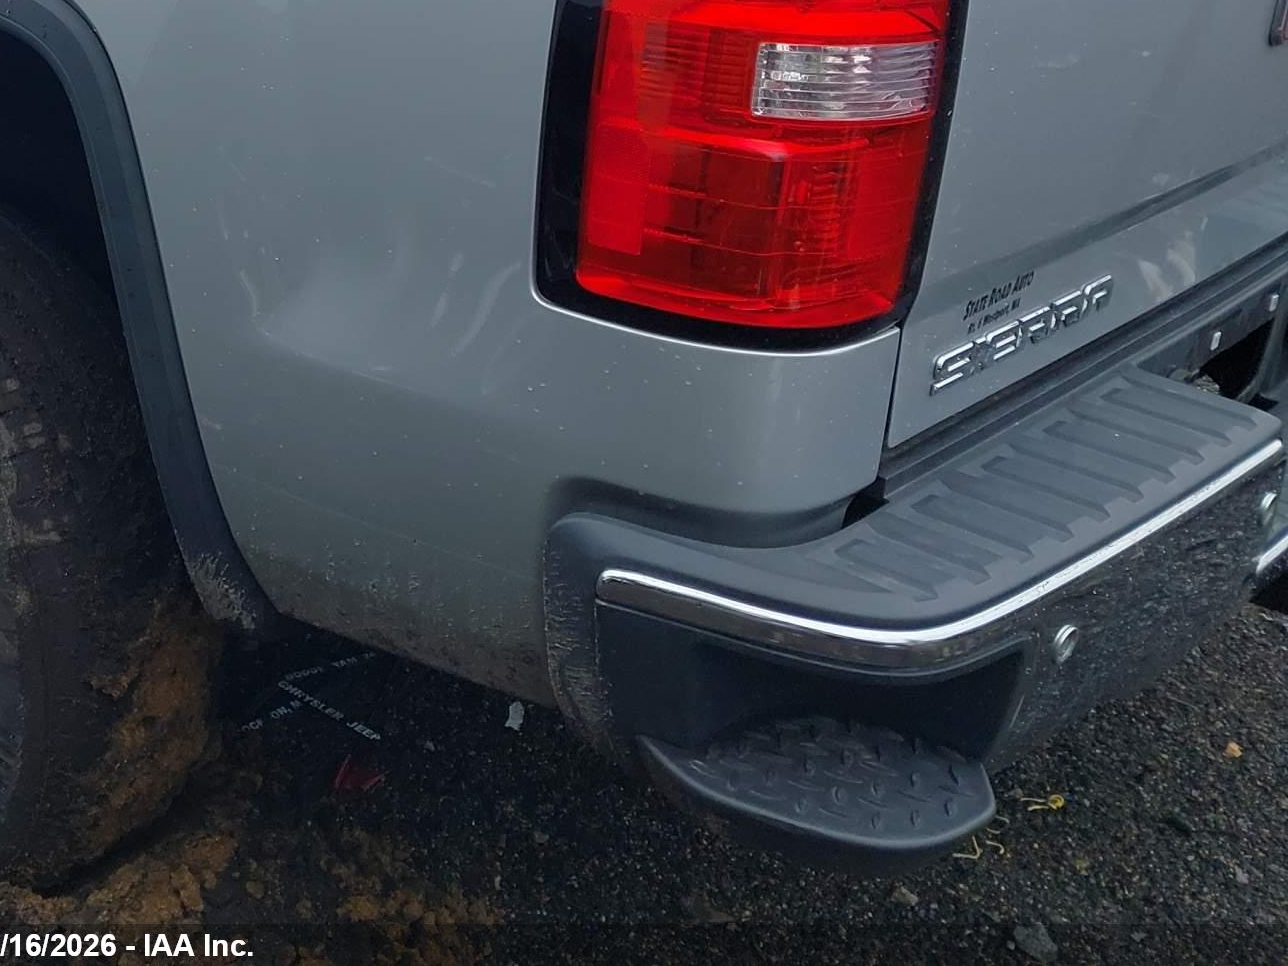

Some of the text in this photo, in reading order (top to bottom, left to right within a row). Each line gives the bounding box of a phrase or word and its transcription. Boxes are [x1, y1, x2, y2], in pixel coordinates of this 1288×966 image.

[929, 274, 1114, 396] SIERRA
[278, 680, 381, 740] CHRYSLER JEEP
